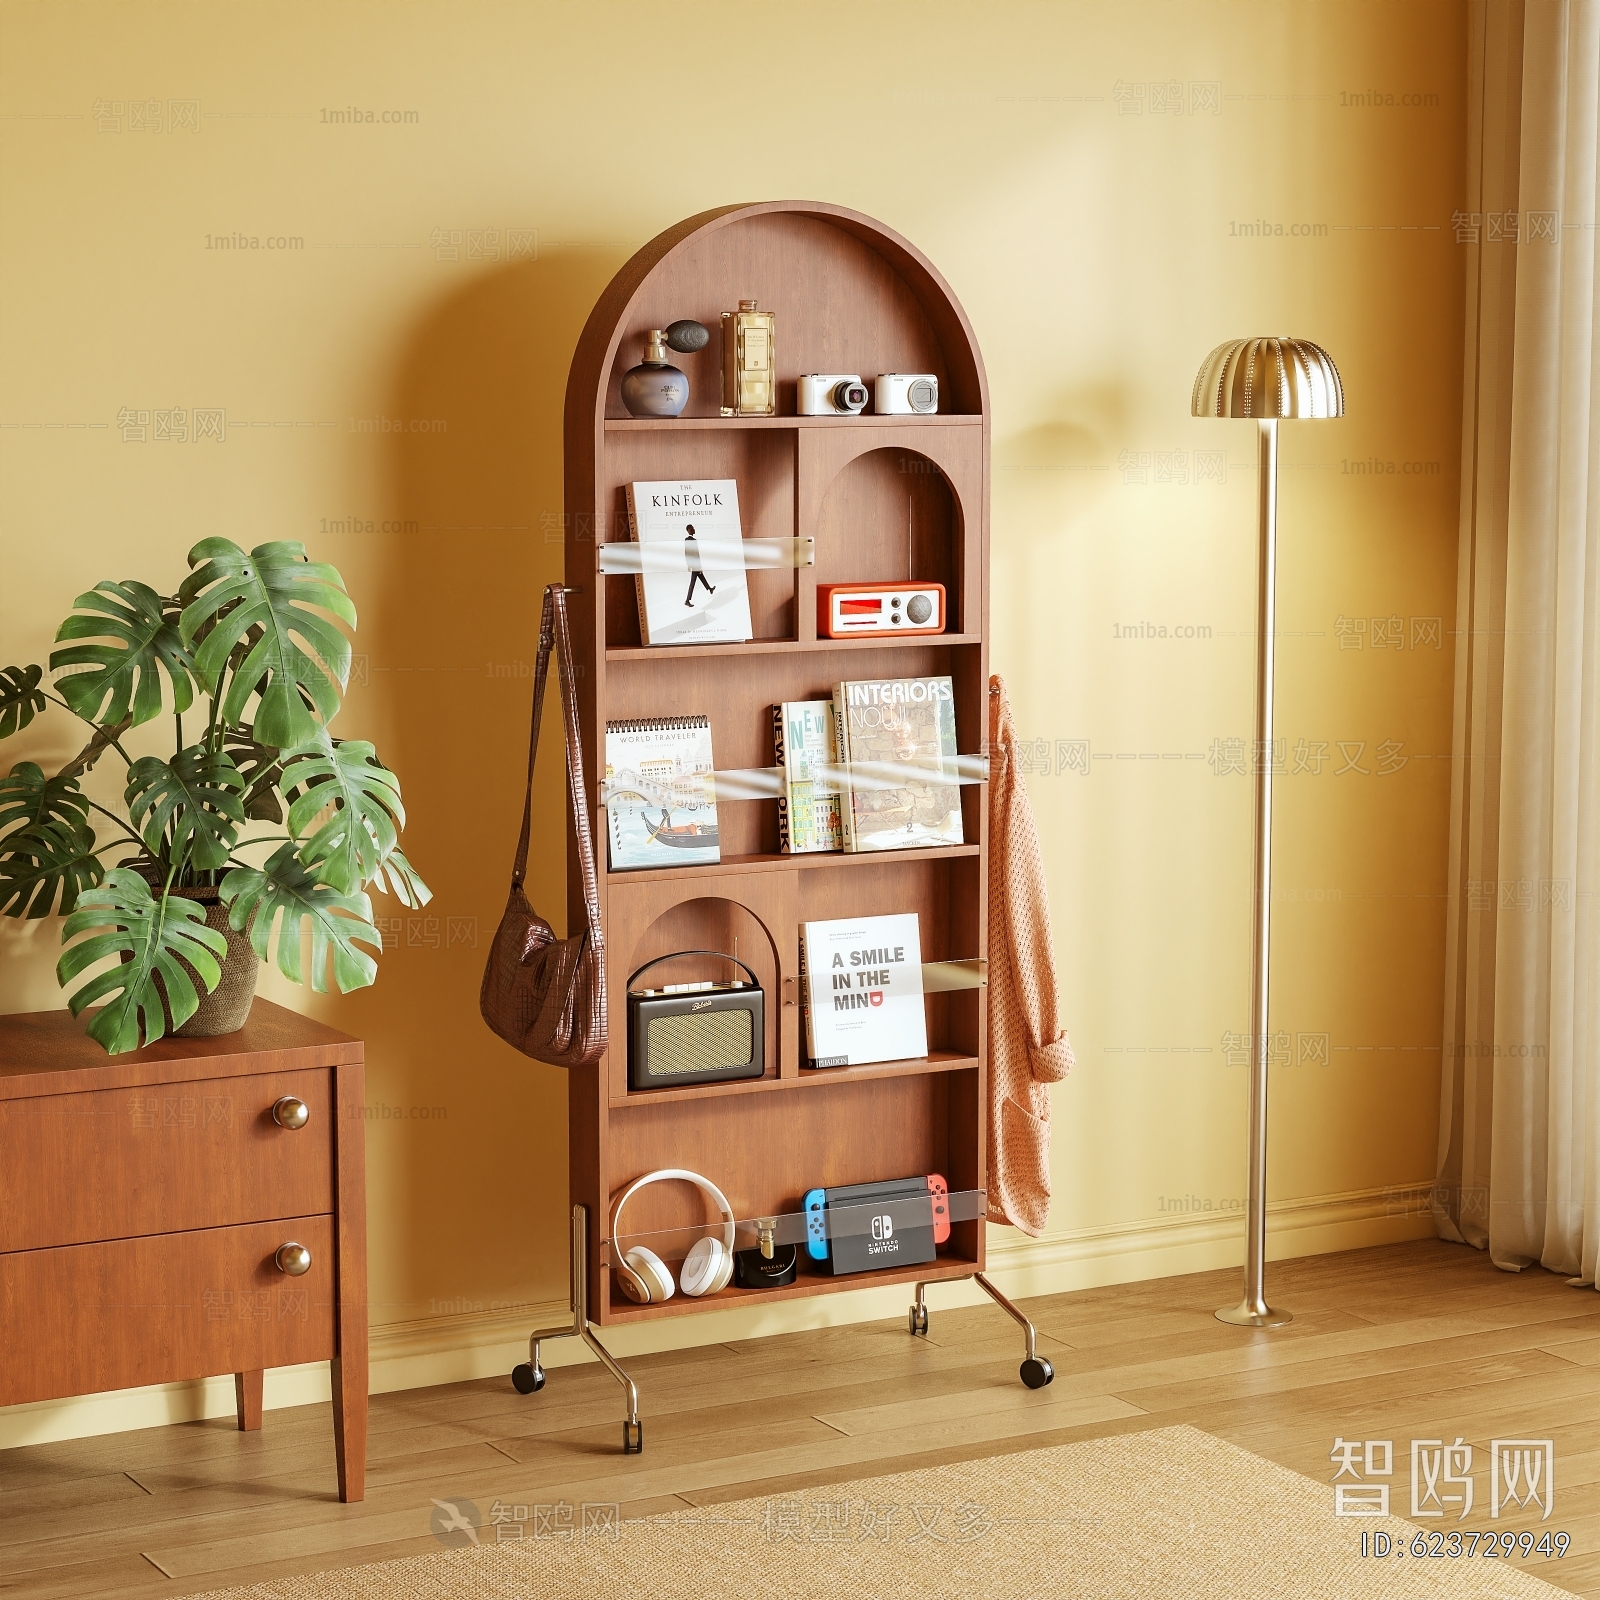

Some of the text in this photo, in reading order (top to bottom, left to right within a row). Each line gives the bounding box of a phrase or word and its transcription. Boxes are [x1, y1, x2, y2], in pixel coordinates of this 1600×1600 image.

[652, 494, 723, 507] KINFOLK
[848, 681, 952, 706] INTERIORS
[655, 732, 696, 741] TRAVELER
[774, 706, 784, 766] NEW
[790, 710, 824, 750] NEW
[906, 822, 913, 832] 2
[832, 946, 904, 968] A SMILE
[832, 970, 890, 990] IN THE
[834, 991, 884, 1011] MIND
[819, 1057, 847, 1067] PHAIDON
[868, 1240, 898, 1248] NINTENDO
[868, 1244, 898, 1254] SWITCH
